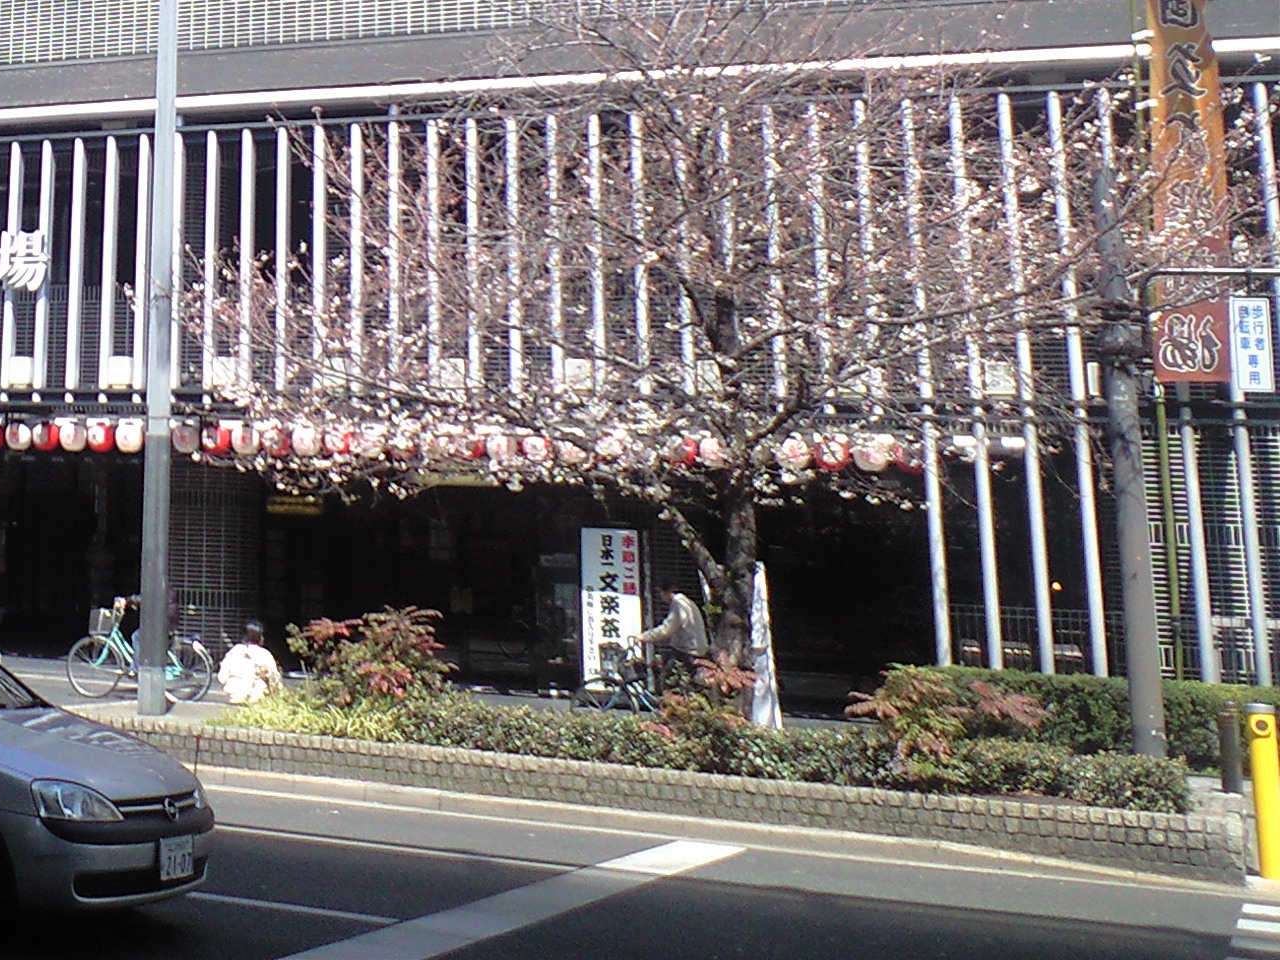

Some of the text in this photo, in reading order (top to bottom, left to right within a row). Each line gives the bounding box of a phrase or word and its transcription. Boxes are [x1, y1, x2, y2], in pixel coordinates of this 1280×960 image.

[1252, 304, 1265, 351] 歩行者
[1248, 354, 1261, 386] 専用
